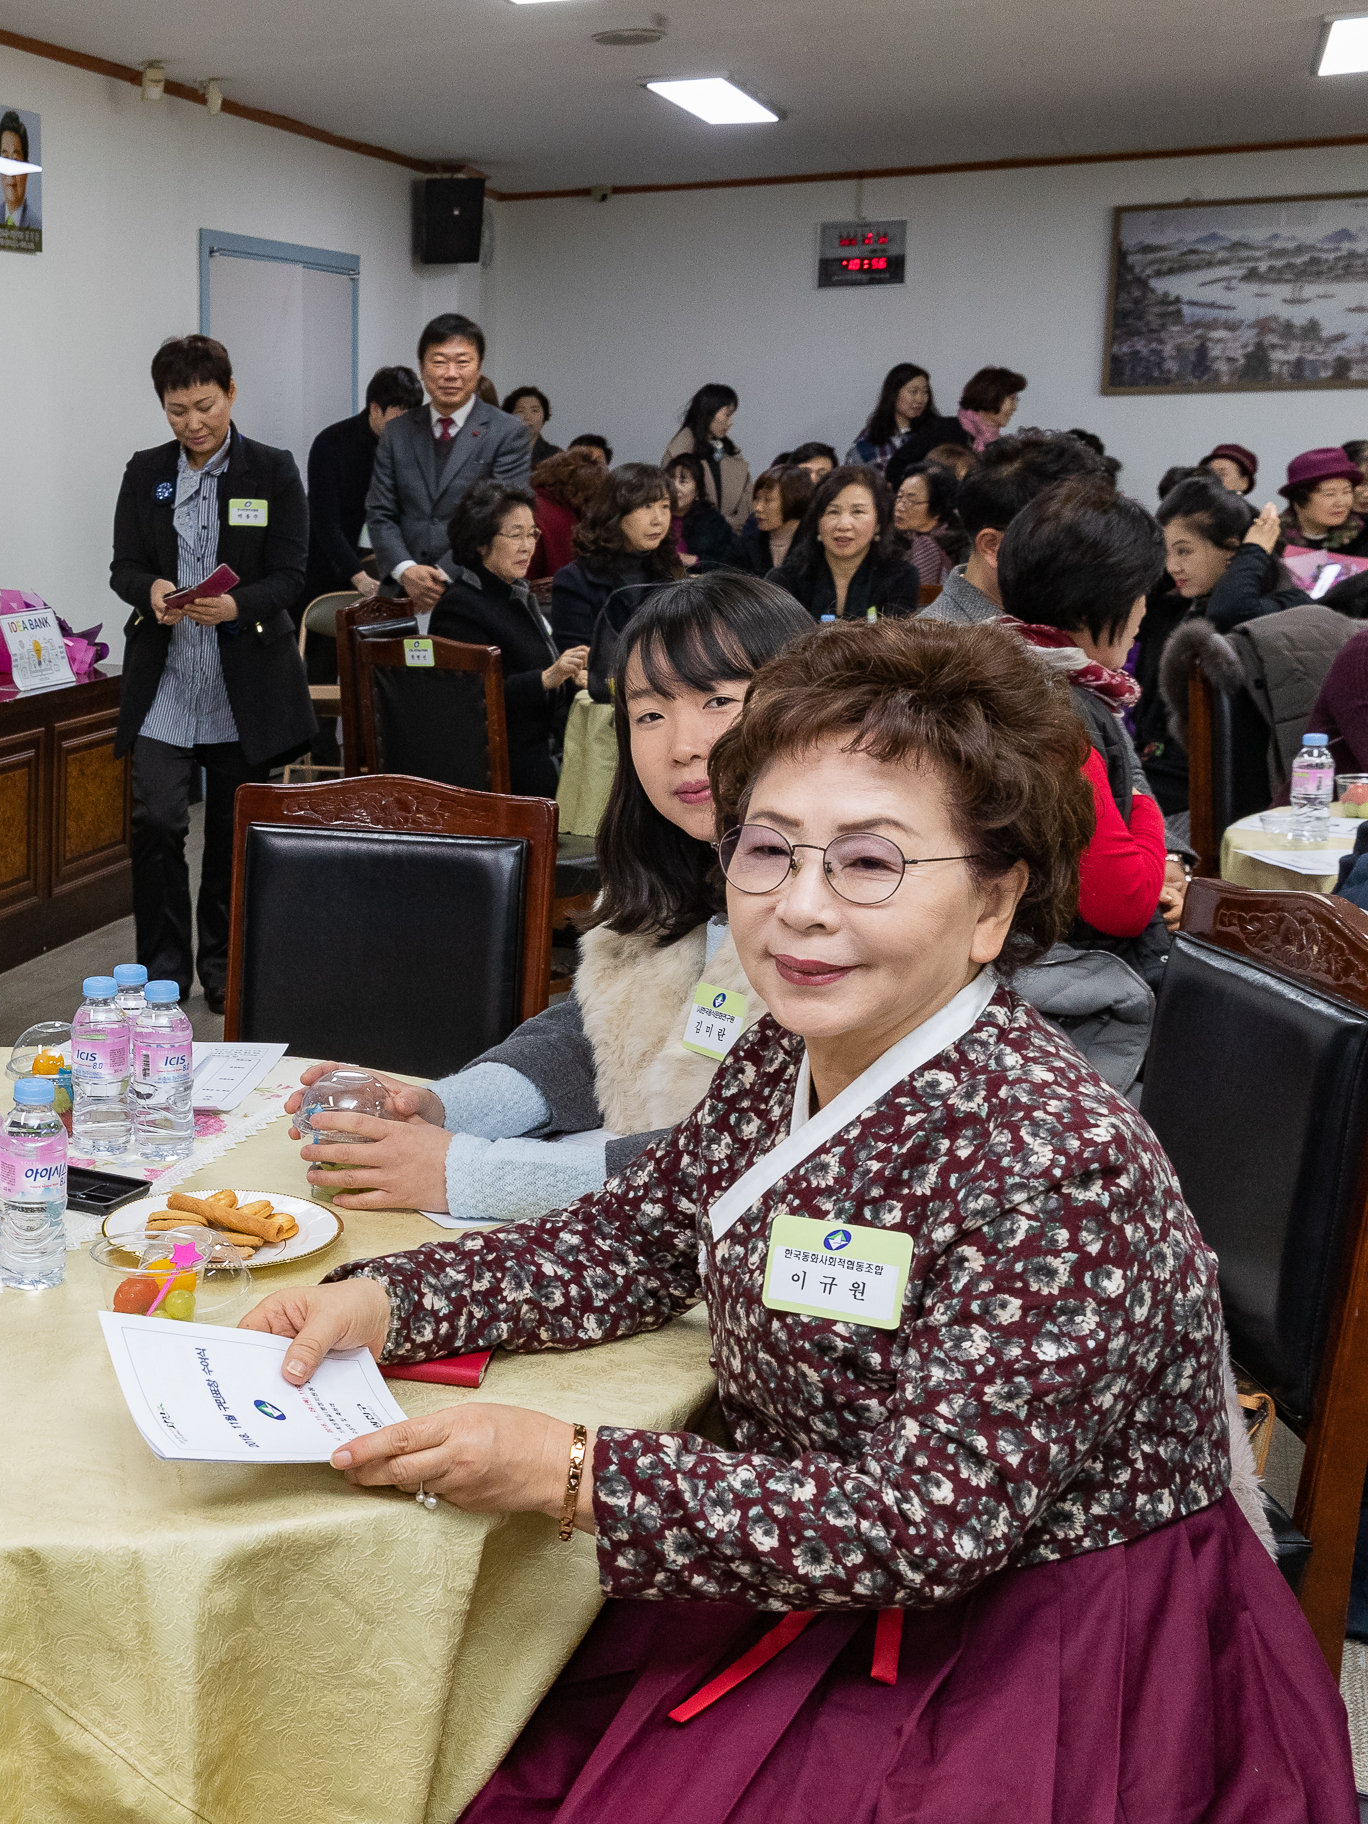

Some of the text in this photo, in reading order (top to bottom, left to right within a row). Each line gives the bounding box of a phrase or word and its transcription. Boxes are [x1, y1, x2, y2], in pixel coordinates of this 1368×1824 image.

[7, 616, 52, 634] IDEA BANK
[76, 1049, 97, 1062] ICIS
[164, 1054, 186, 1066] ICIS
[92, 1062, 104, 1070] 8.0
[784, 1248, 884, 1276] 한국동화사회적협동조합
[194, 1347, 214, 1376] 수여식
[222, 1413, 242, 1429] 11월
